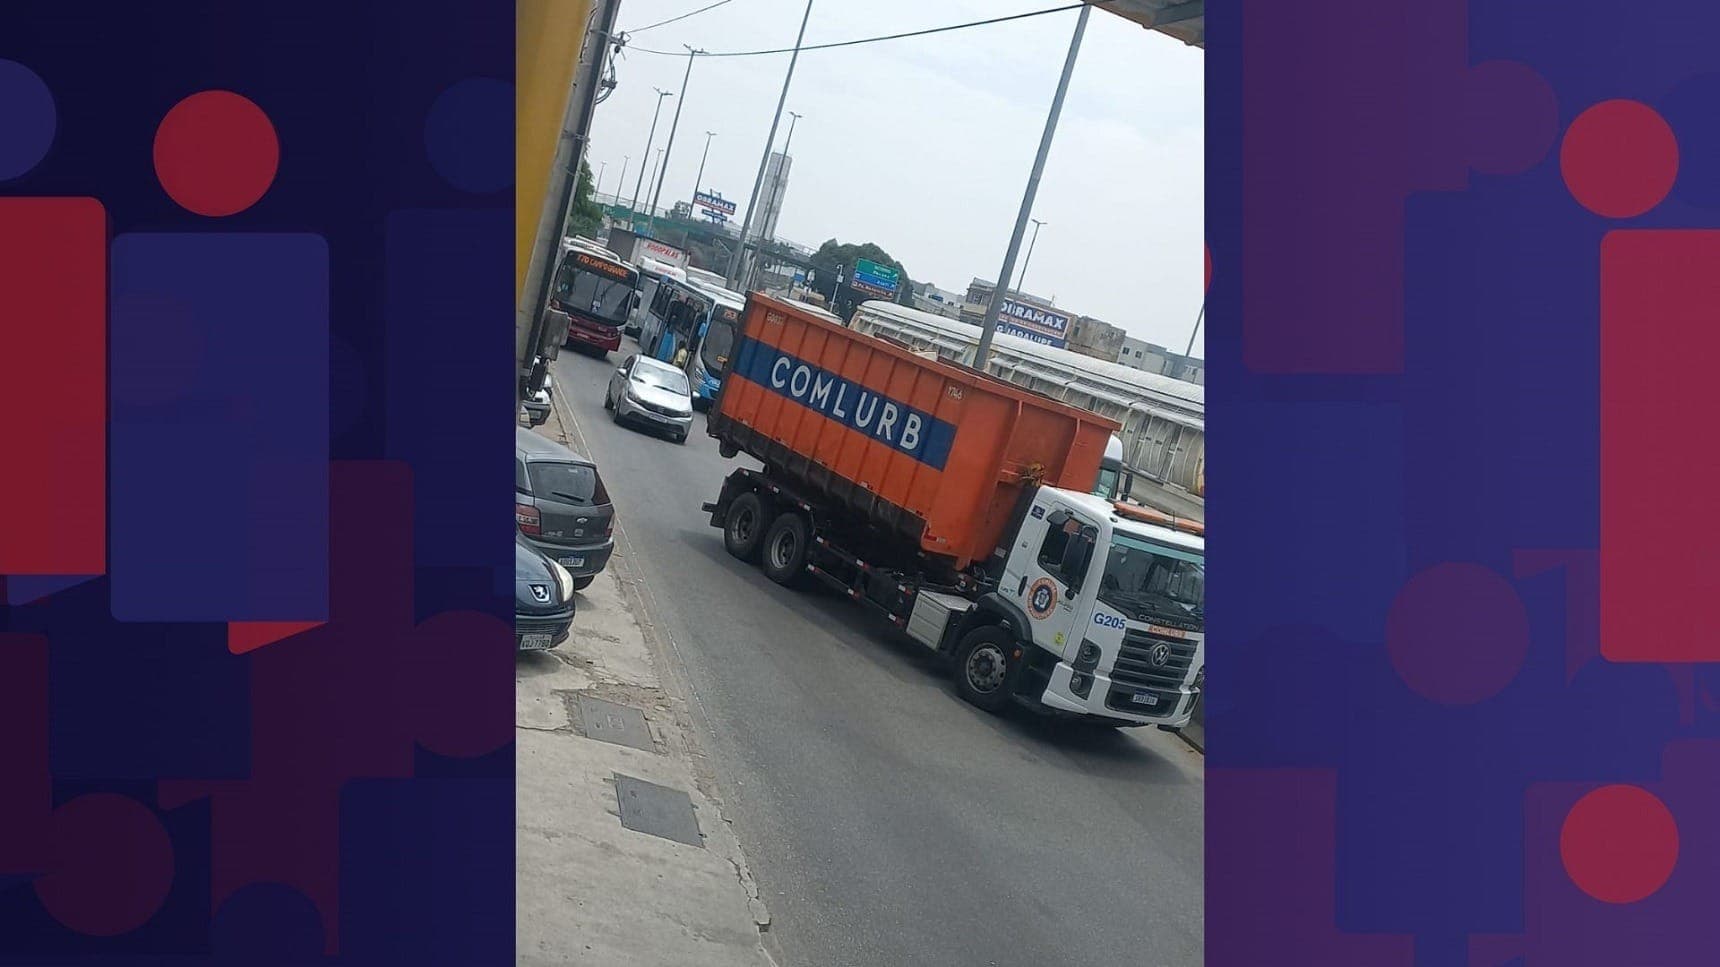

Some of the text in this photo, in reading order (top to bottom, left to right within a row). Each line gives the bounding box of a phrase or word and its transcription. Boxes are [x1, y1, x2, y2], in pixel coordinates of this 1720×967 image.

[697, 194, 734, 210] OBRAMAX
[771, 357, 922, 450] COMLURB
[1094, 612, 1126, 629] G205
[1138, 614, 1199, 631] CONSTELLATION
